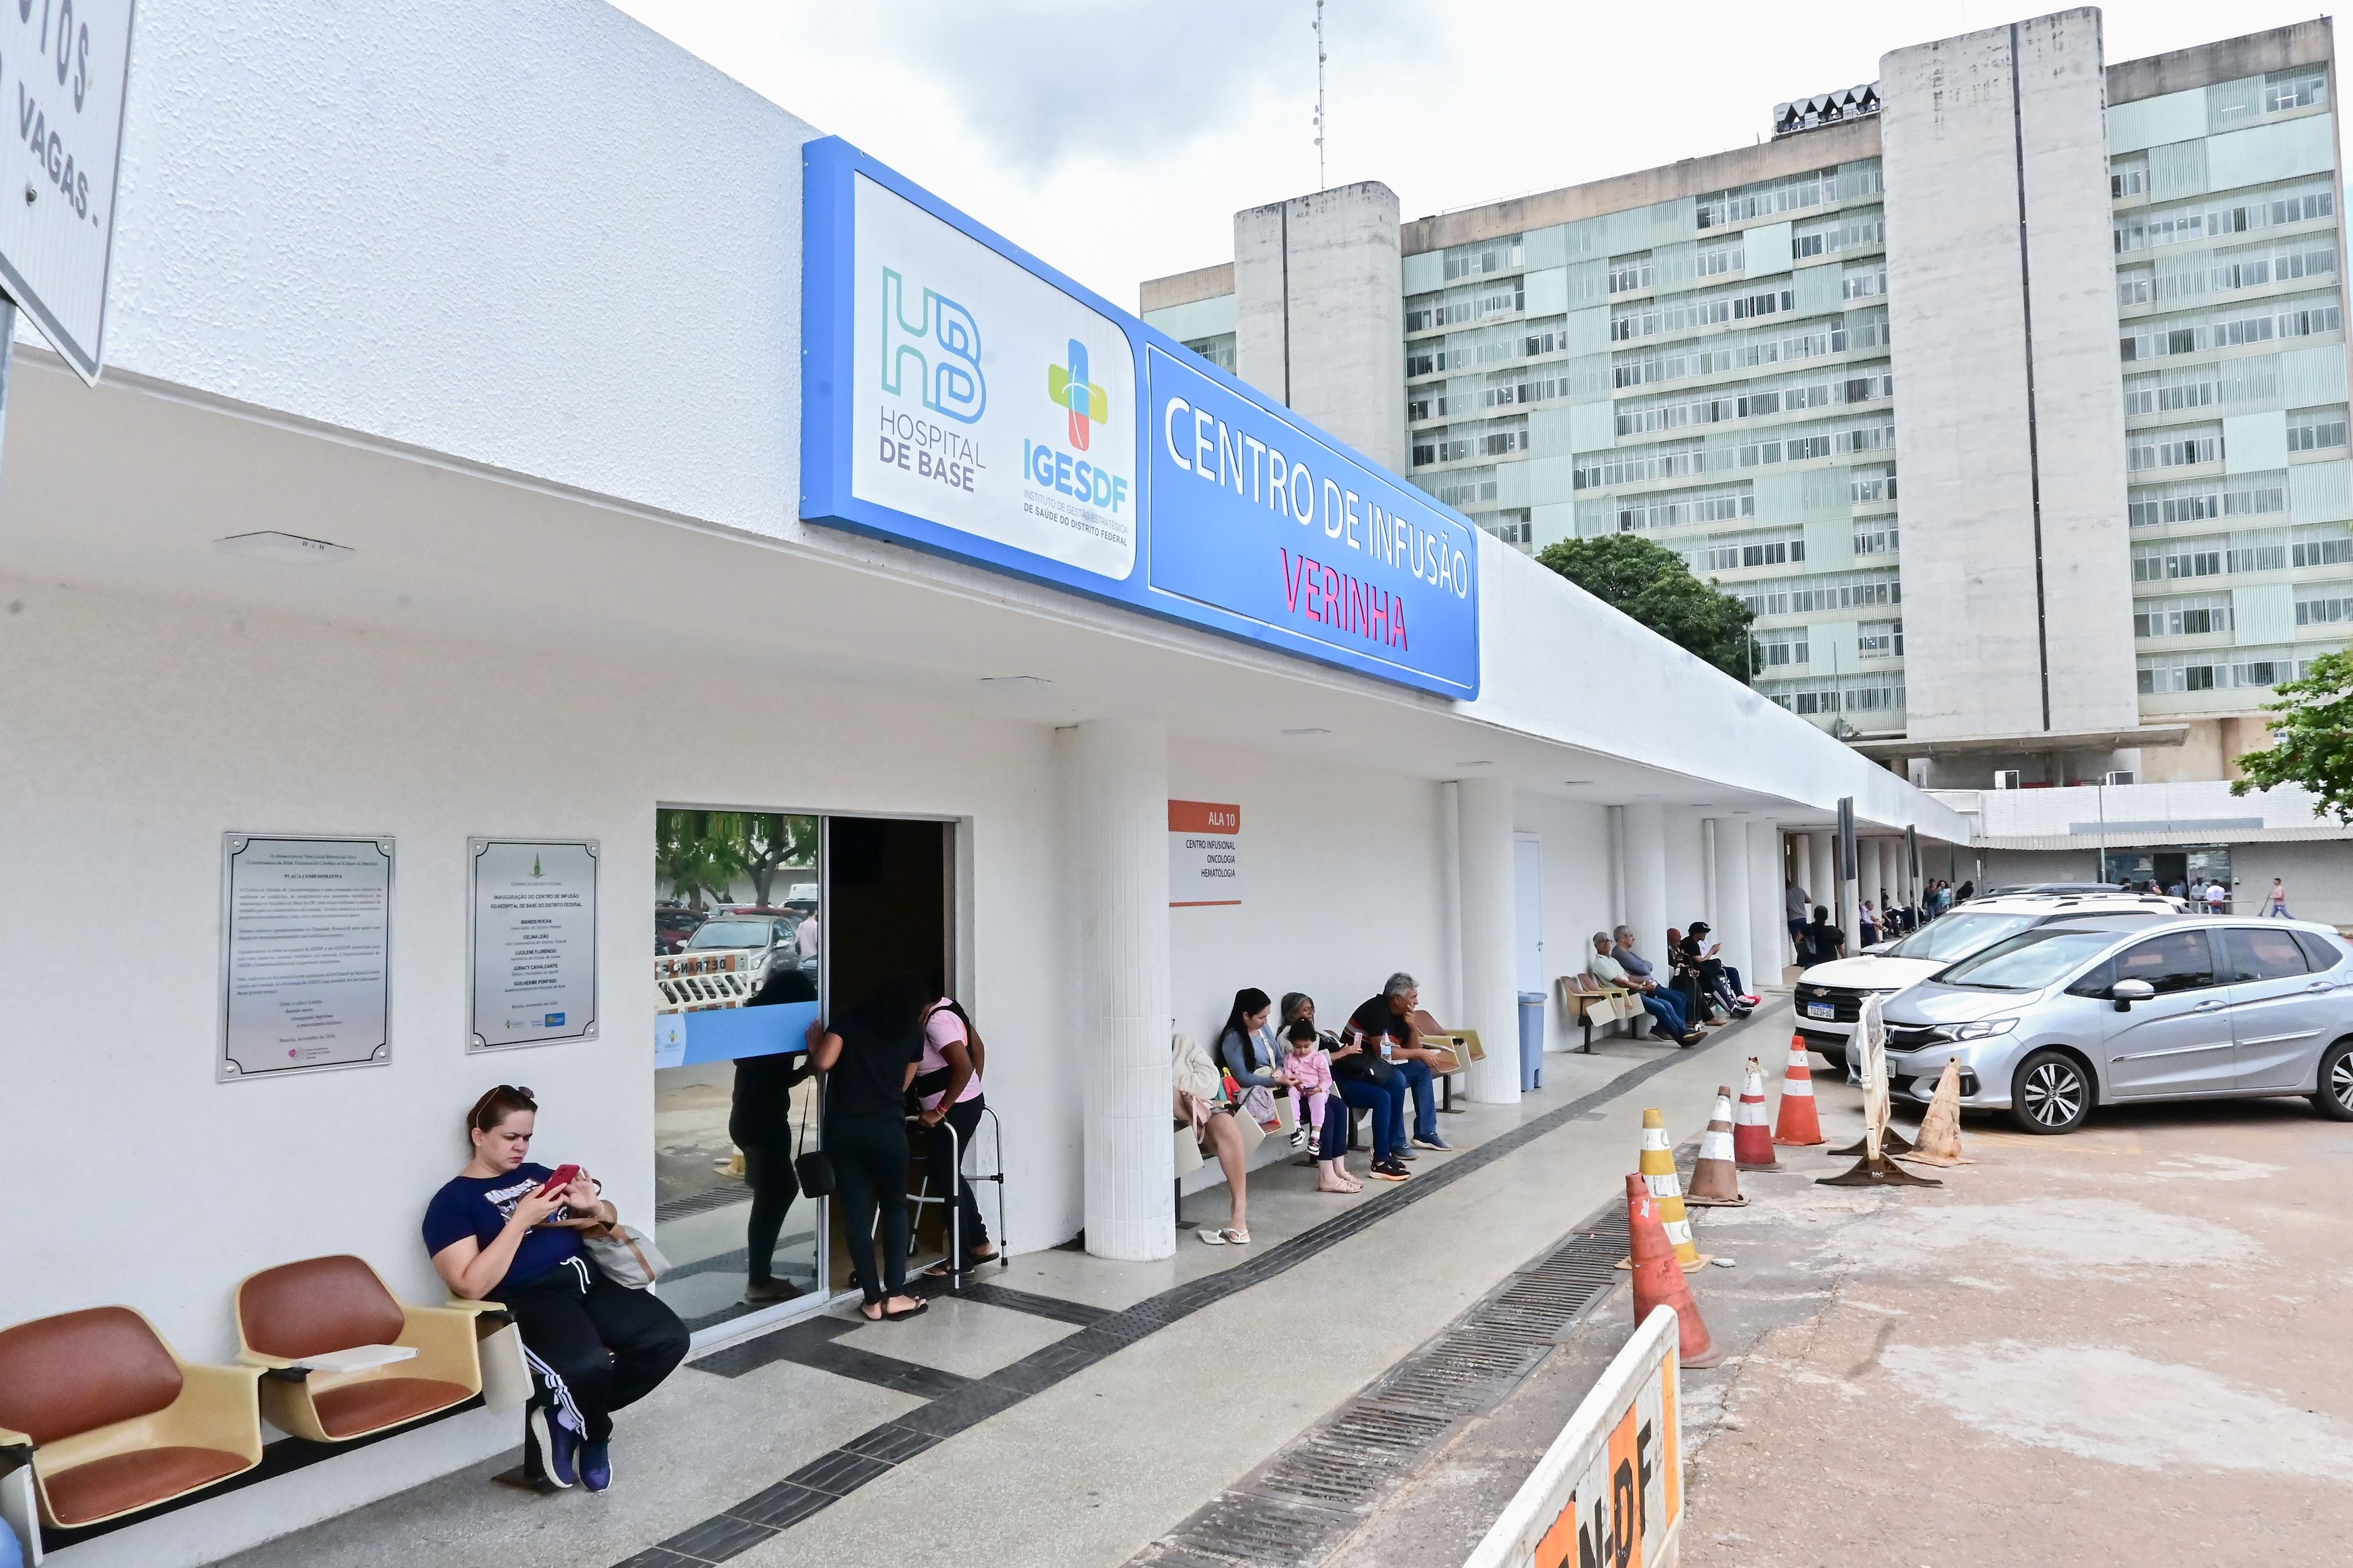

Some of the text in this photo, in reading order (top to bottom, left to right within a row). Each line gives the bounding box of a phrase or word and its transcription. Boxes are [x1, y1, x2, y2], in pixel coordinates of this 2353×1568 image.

[18, 0, 89, 114] OS
[881, 405, 986, 470] HOSPITAL
[880, 435, 975, 493] DE BASE
[1024, 438, 1128, 514] IGESDF
[1024, 489, 1128, 534] INSTITUTO DE GESTÃO ESTRATÉGICA
[1164, 396, 1469, 600] CENTRO DE INFUSÃO
[1024, 503, 1128, 546] DE SAÚDE DO DISTRITO FEDERAL
[1280, 547, 1408, 652] VERINHA
[1186, 839, 1235, 850] CENTRO INFUSIONAL
[1209, 812, 1235, 827] ALA 10
[1201, 868, 1235, 878] HEMATOLOGIA
[1207, 854, 1235, 864] ONCOLOGIA
